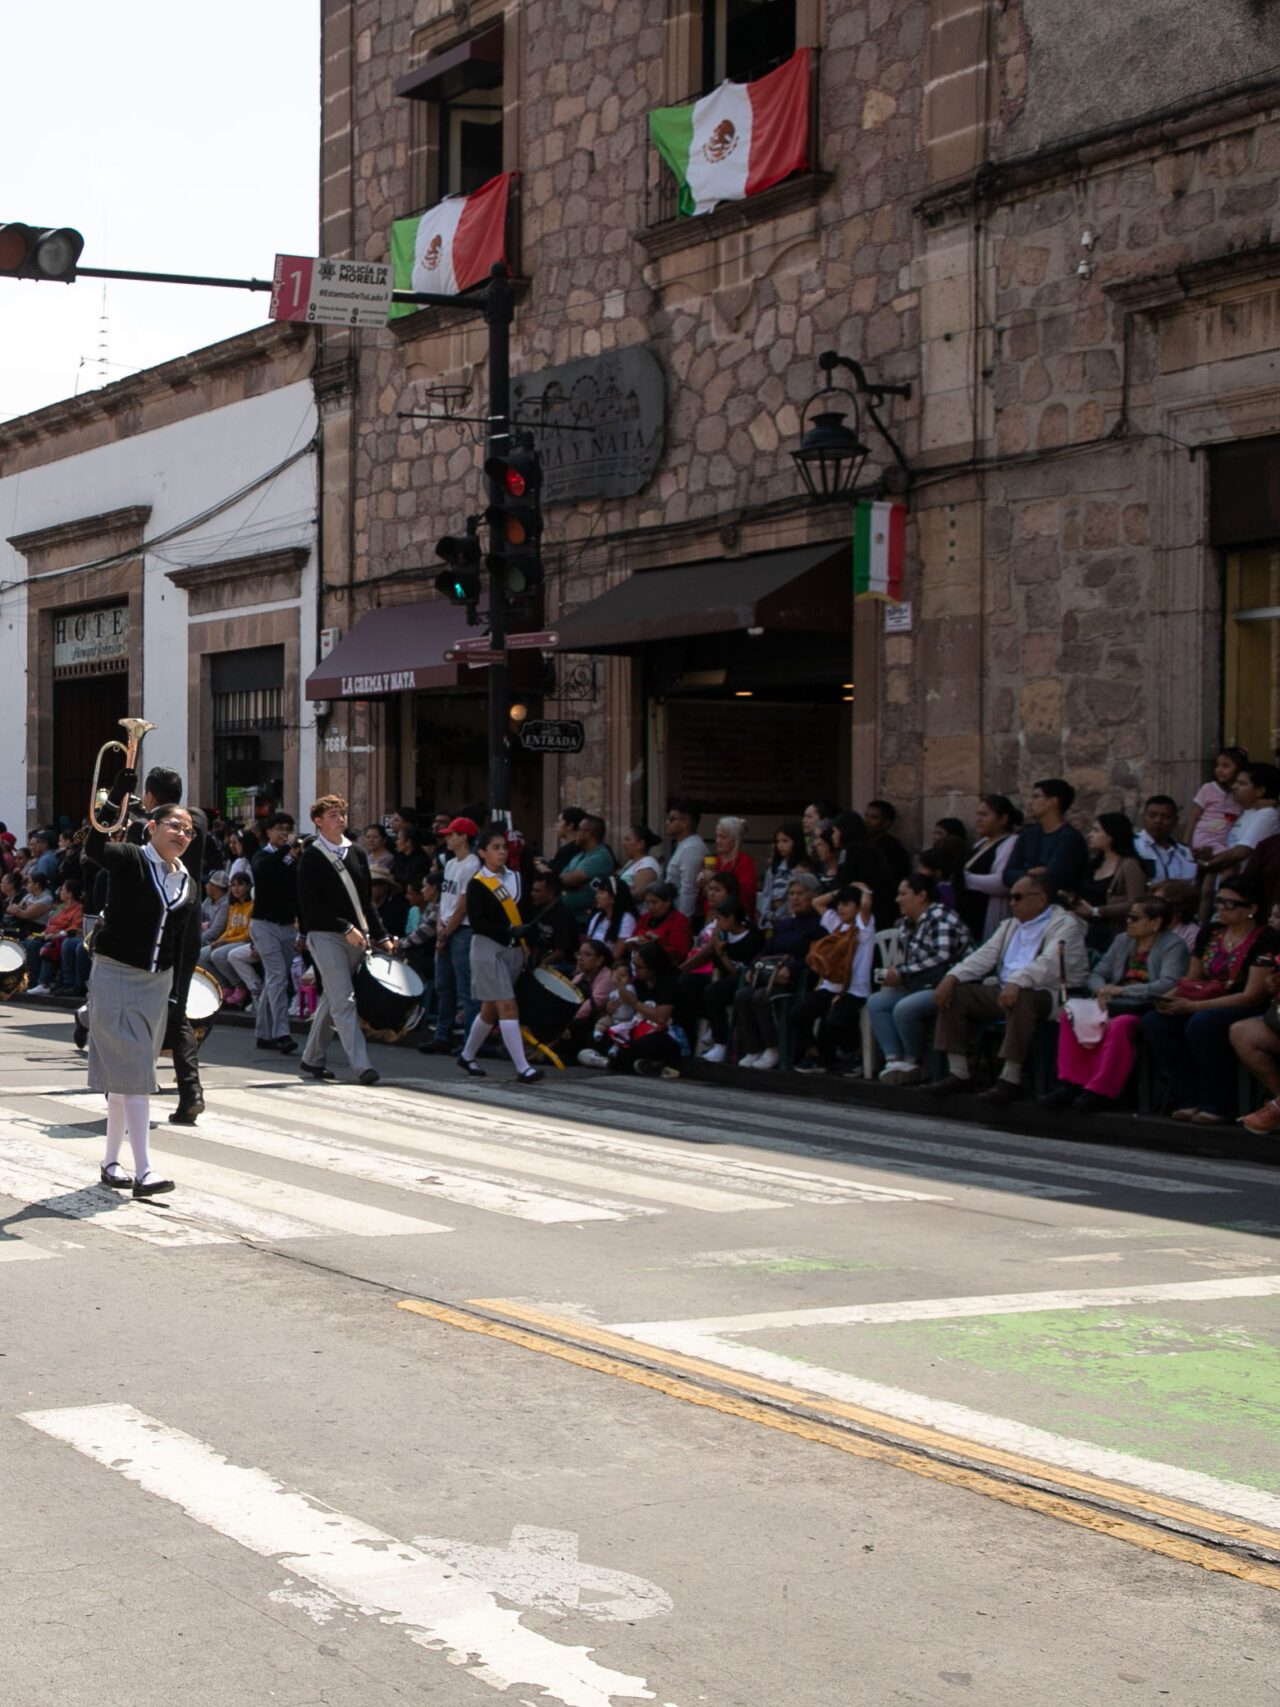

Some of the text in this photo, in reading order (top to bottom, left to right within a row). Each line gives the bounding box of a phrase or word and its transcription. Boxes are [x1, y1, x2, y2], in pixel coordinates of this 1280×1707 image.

[339, 272, 387, 285] MORELIA
[340, 263, 388, 276] POLICÍA DE
[290, 270, 302, 307] 1
[591, 429, 645, 457] NATA
[55, 609, 124, 645] HOTE
[341, 671, 416, 694] LA CREMA Y NATA
[525, 734, 577, 747] ENTRADA
